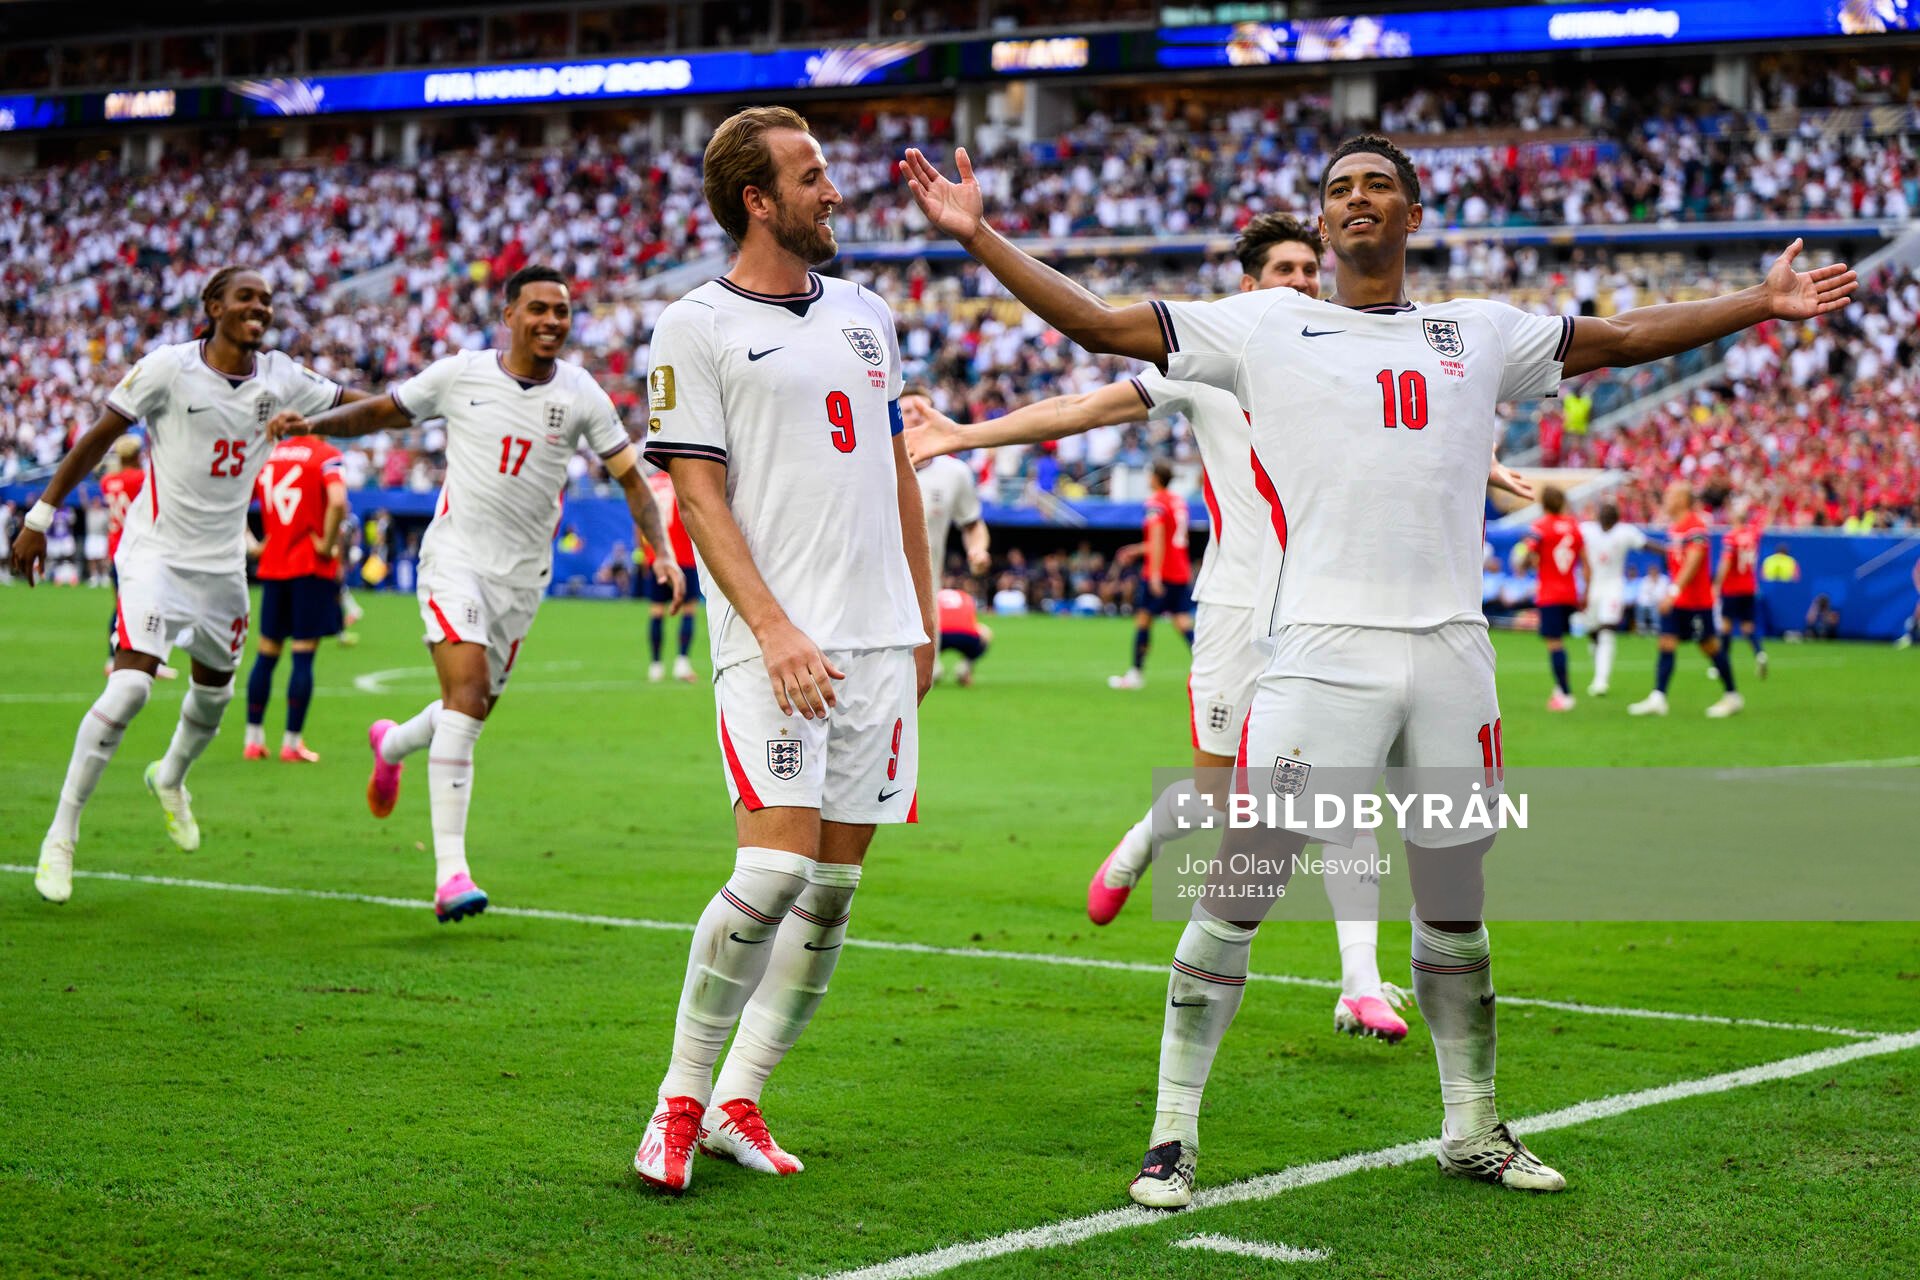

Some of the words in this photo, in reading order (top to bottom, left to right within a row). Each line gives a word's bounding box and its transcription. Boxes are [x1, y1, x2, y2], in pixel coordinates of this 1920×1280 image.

[826, 390, 857, 454] 9
[1376, 369, 1429, 431] 10
[210, 439, 248, 478] 25
[498, 434, 533, 477] 17
[258, 463, 303, 526] 16
[886, 717, 903, 781] 9
[1477, 717, 1504, 788] 10
